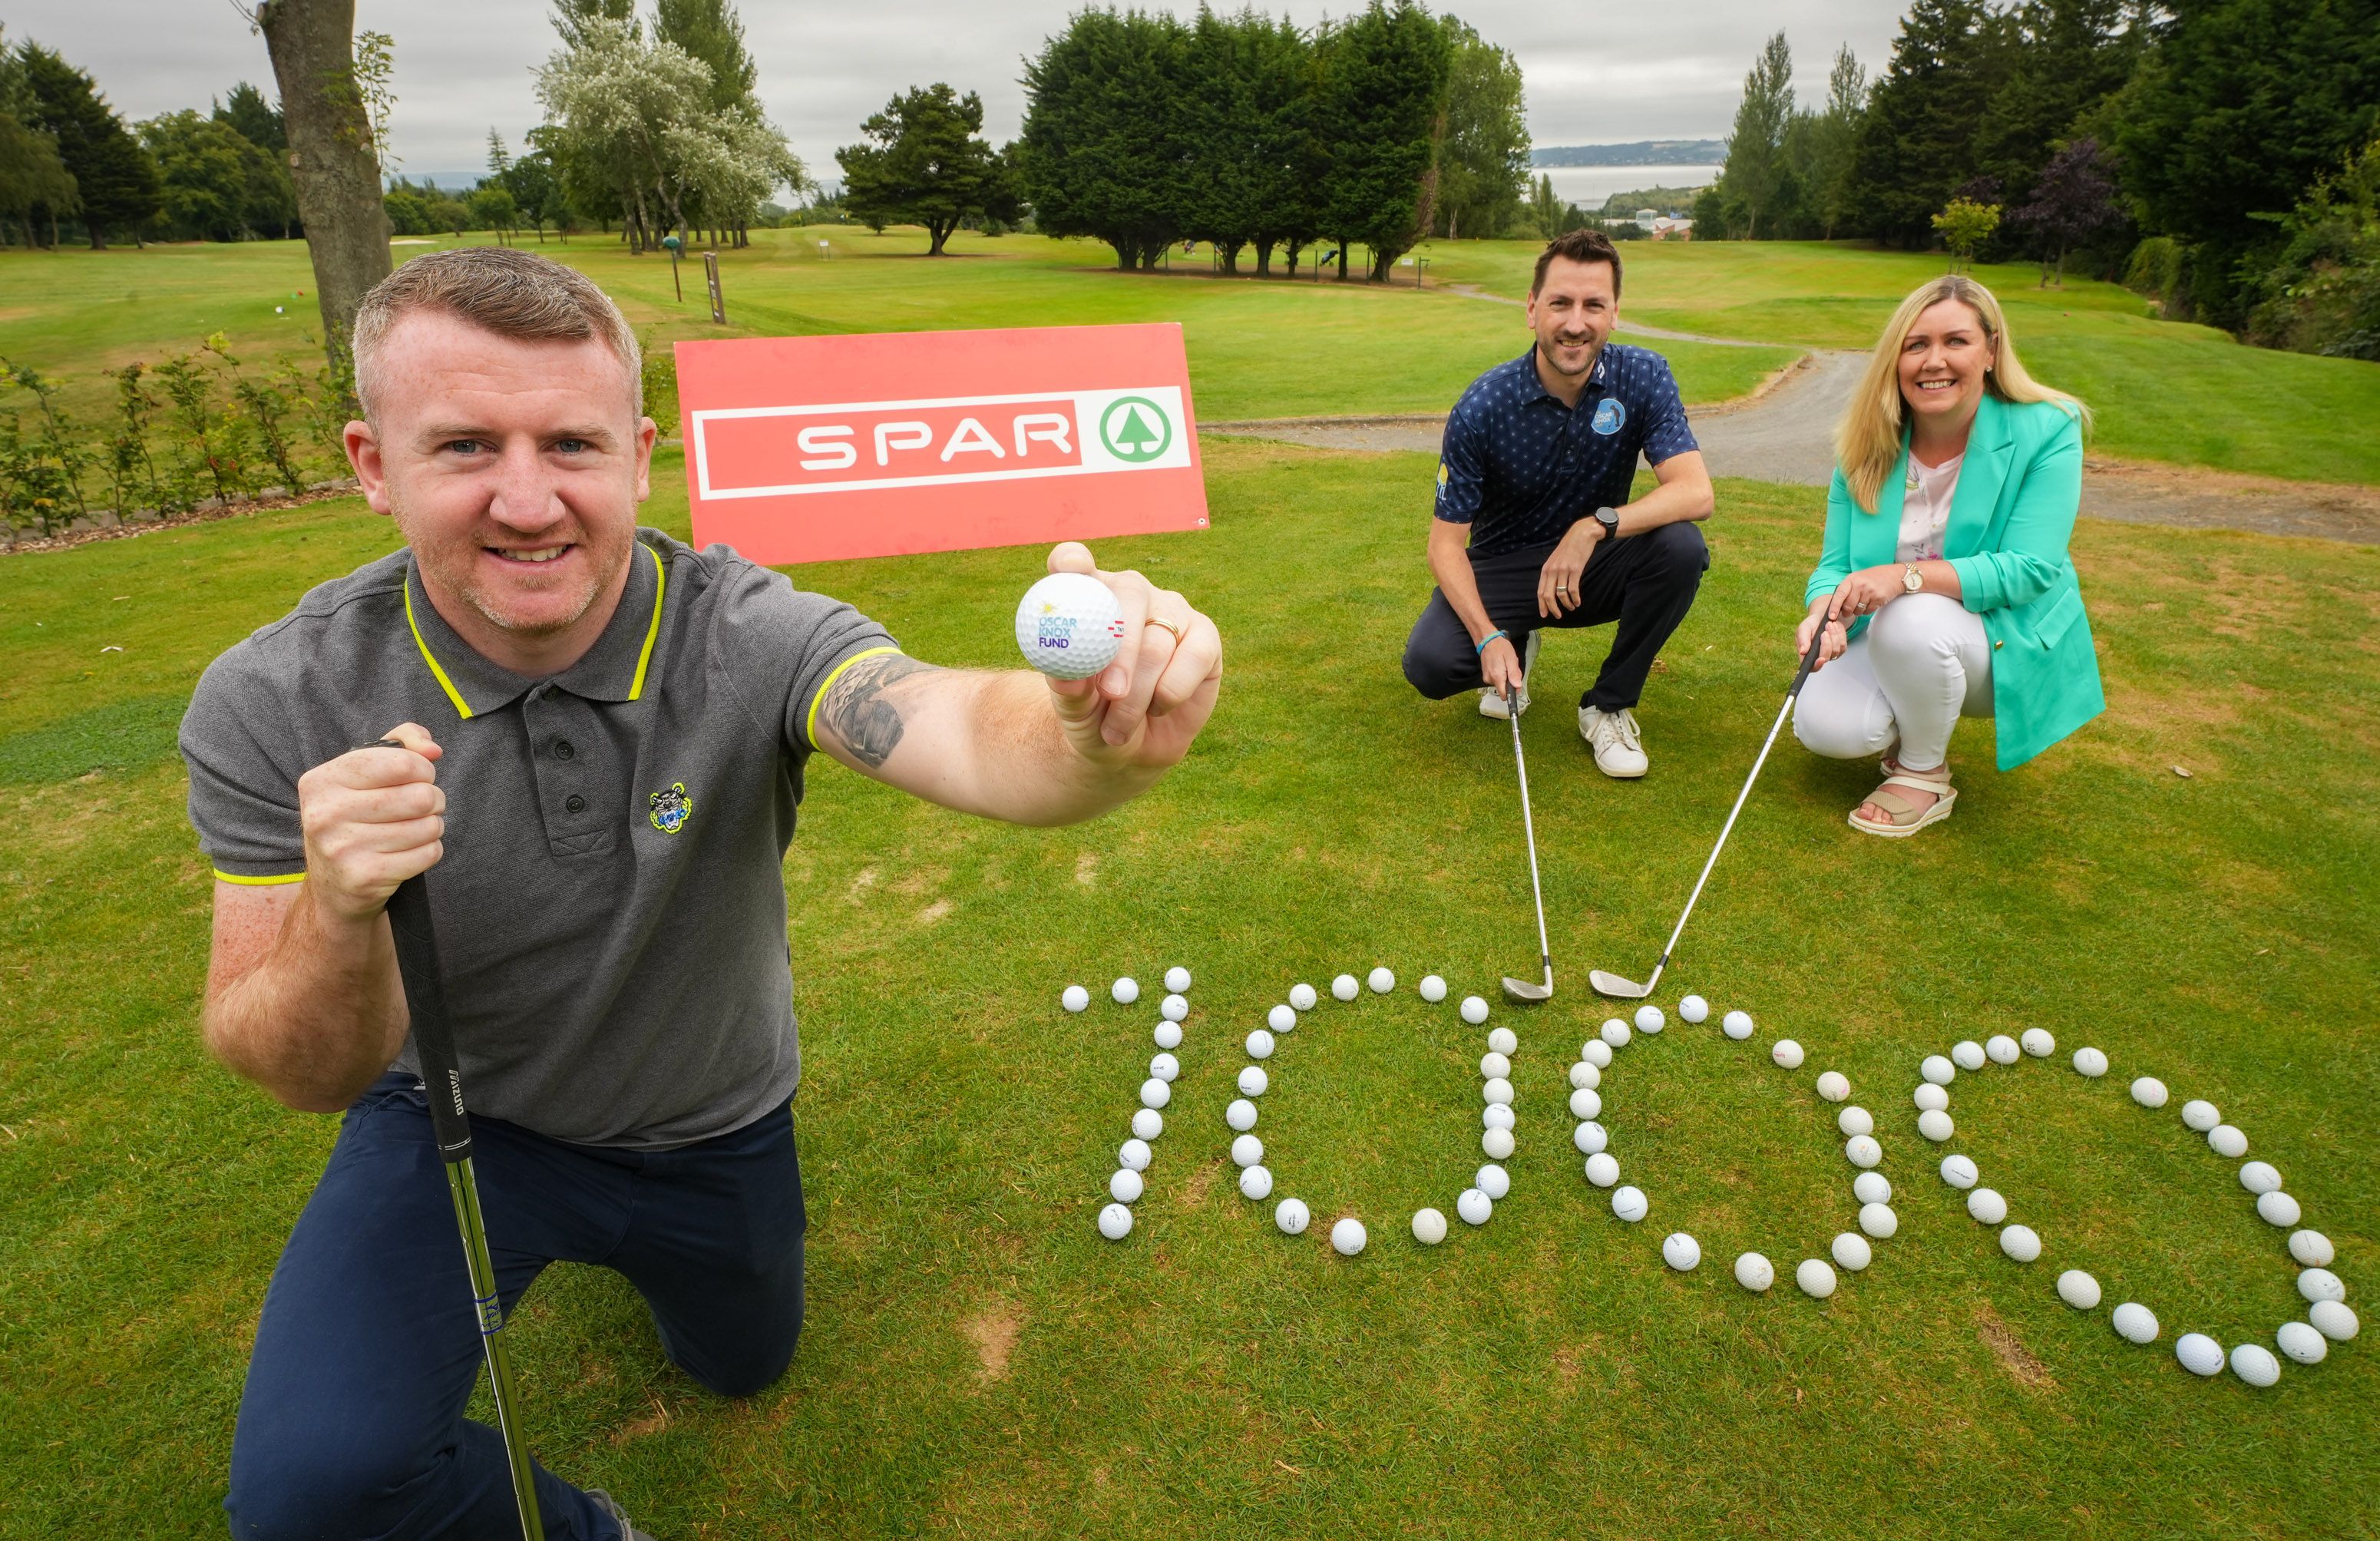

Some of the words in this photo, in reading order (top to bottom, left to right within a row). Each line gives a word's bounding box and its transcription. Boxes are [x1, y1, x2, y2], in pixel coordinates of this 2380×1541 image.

[796, 413, 1072, 471] SPAR
[1039, 617, 1077, 628] OSCAR
[1039, 627, 1072, 638] KNOX
[1039, 637, 1069, 649] FUND
